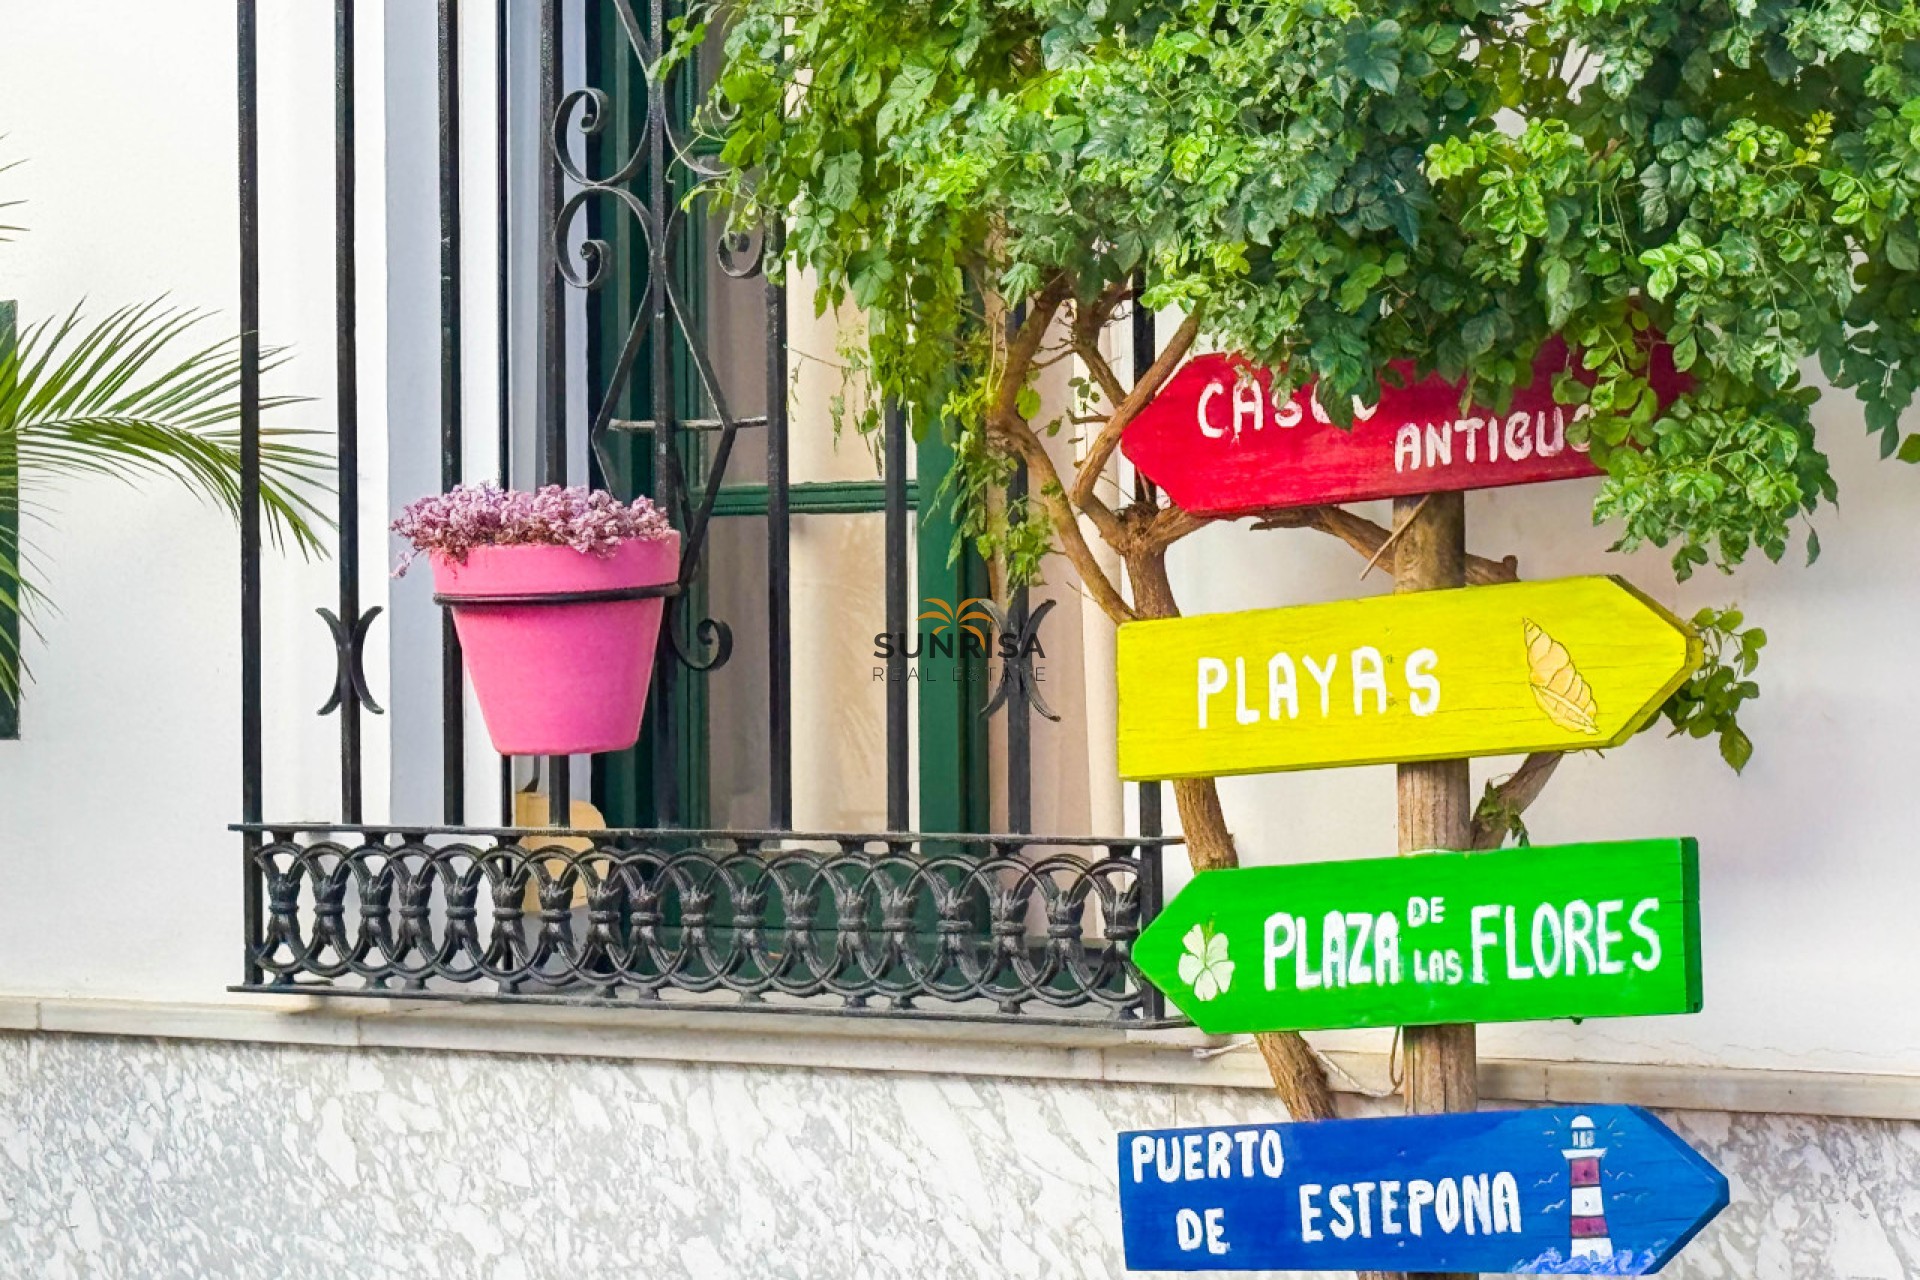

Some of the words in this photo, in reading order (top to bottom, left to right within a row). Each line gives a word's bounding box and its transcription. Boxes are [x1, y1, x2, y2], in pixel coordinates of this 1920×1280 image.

[1198, 646, 1441, 729] PLAYAS
[1263, 910, 1400, 991] PLAZA
[1407, 896, 1445, 928] DE
[1471, 897, 1661, 984] FLORES
[1414, 949, 1462, 985] LAS
[1131, 1129, 1285, 1184] PUERTO
[1175, 1208, 1230, 1255] DE
[1300, 1171, 1521, 1243] ESTEPONA
